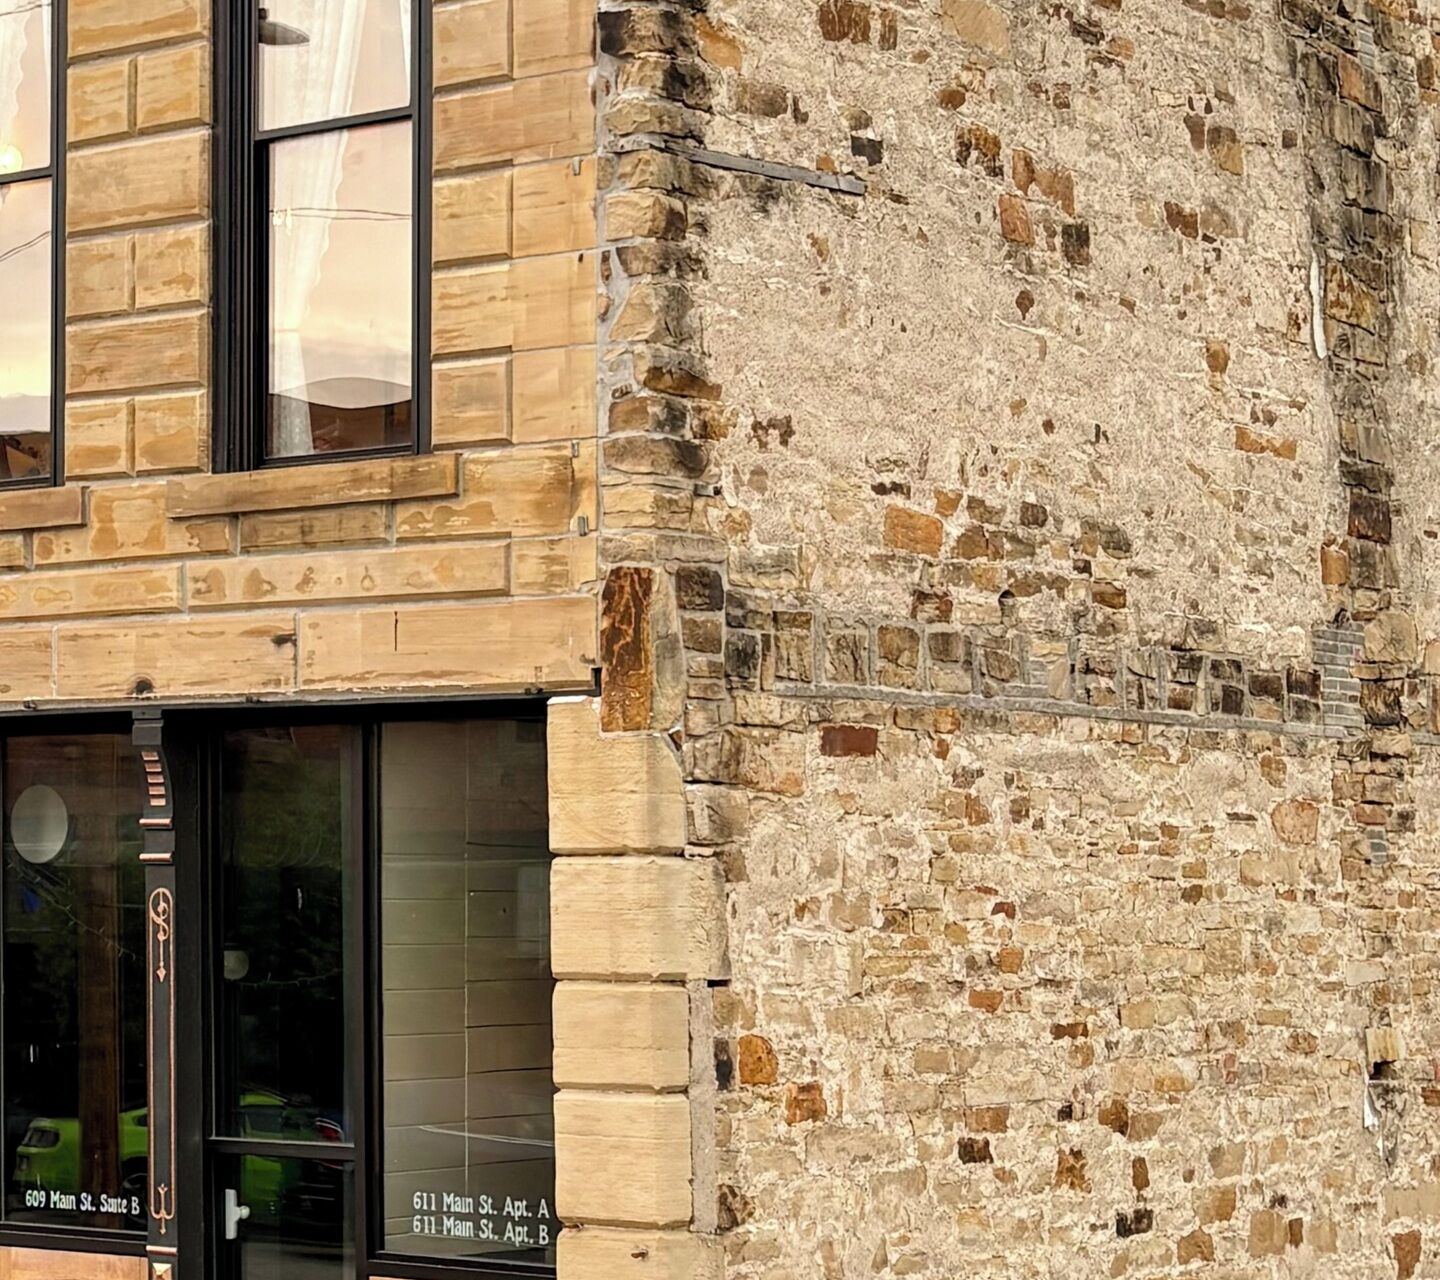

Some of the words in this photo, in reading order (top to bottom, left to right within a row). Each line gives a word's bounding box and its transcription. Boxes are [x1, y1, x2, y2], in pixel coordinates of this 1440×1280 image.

[25, 1190, 46, 1208] 609
[50, 1191, 77, 1211] Main
[79, 1192, 96, 1212] St.
[100, 1194, 128, 1214] Suite
[131, 1196, 140, 1215] B
[413, 1191, 436, 1211] 611
[442, 1192, 474, 1213] Main
[478, 1194, 498, 1216] St.
[502, 1196, 533, 1222] Apt.
[537, 1199, 550, 1219] A
[413, 1215, 436, 1235] 611
[442, 1215, 474, 1238] Main
[478, 1218, 498, 1240] St.
[503, 1221, 534, 1247] Apt.
[538, 1225, 550, 1245] B
